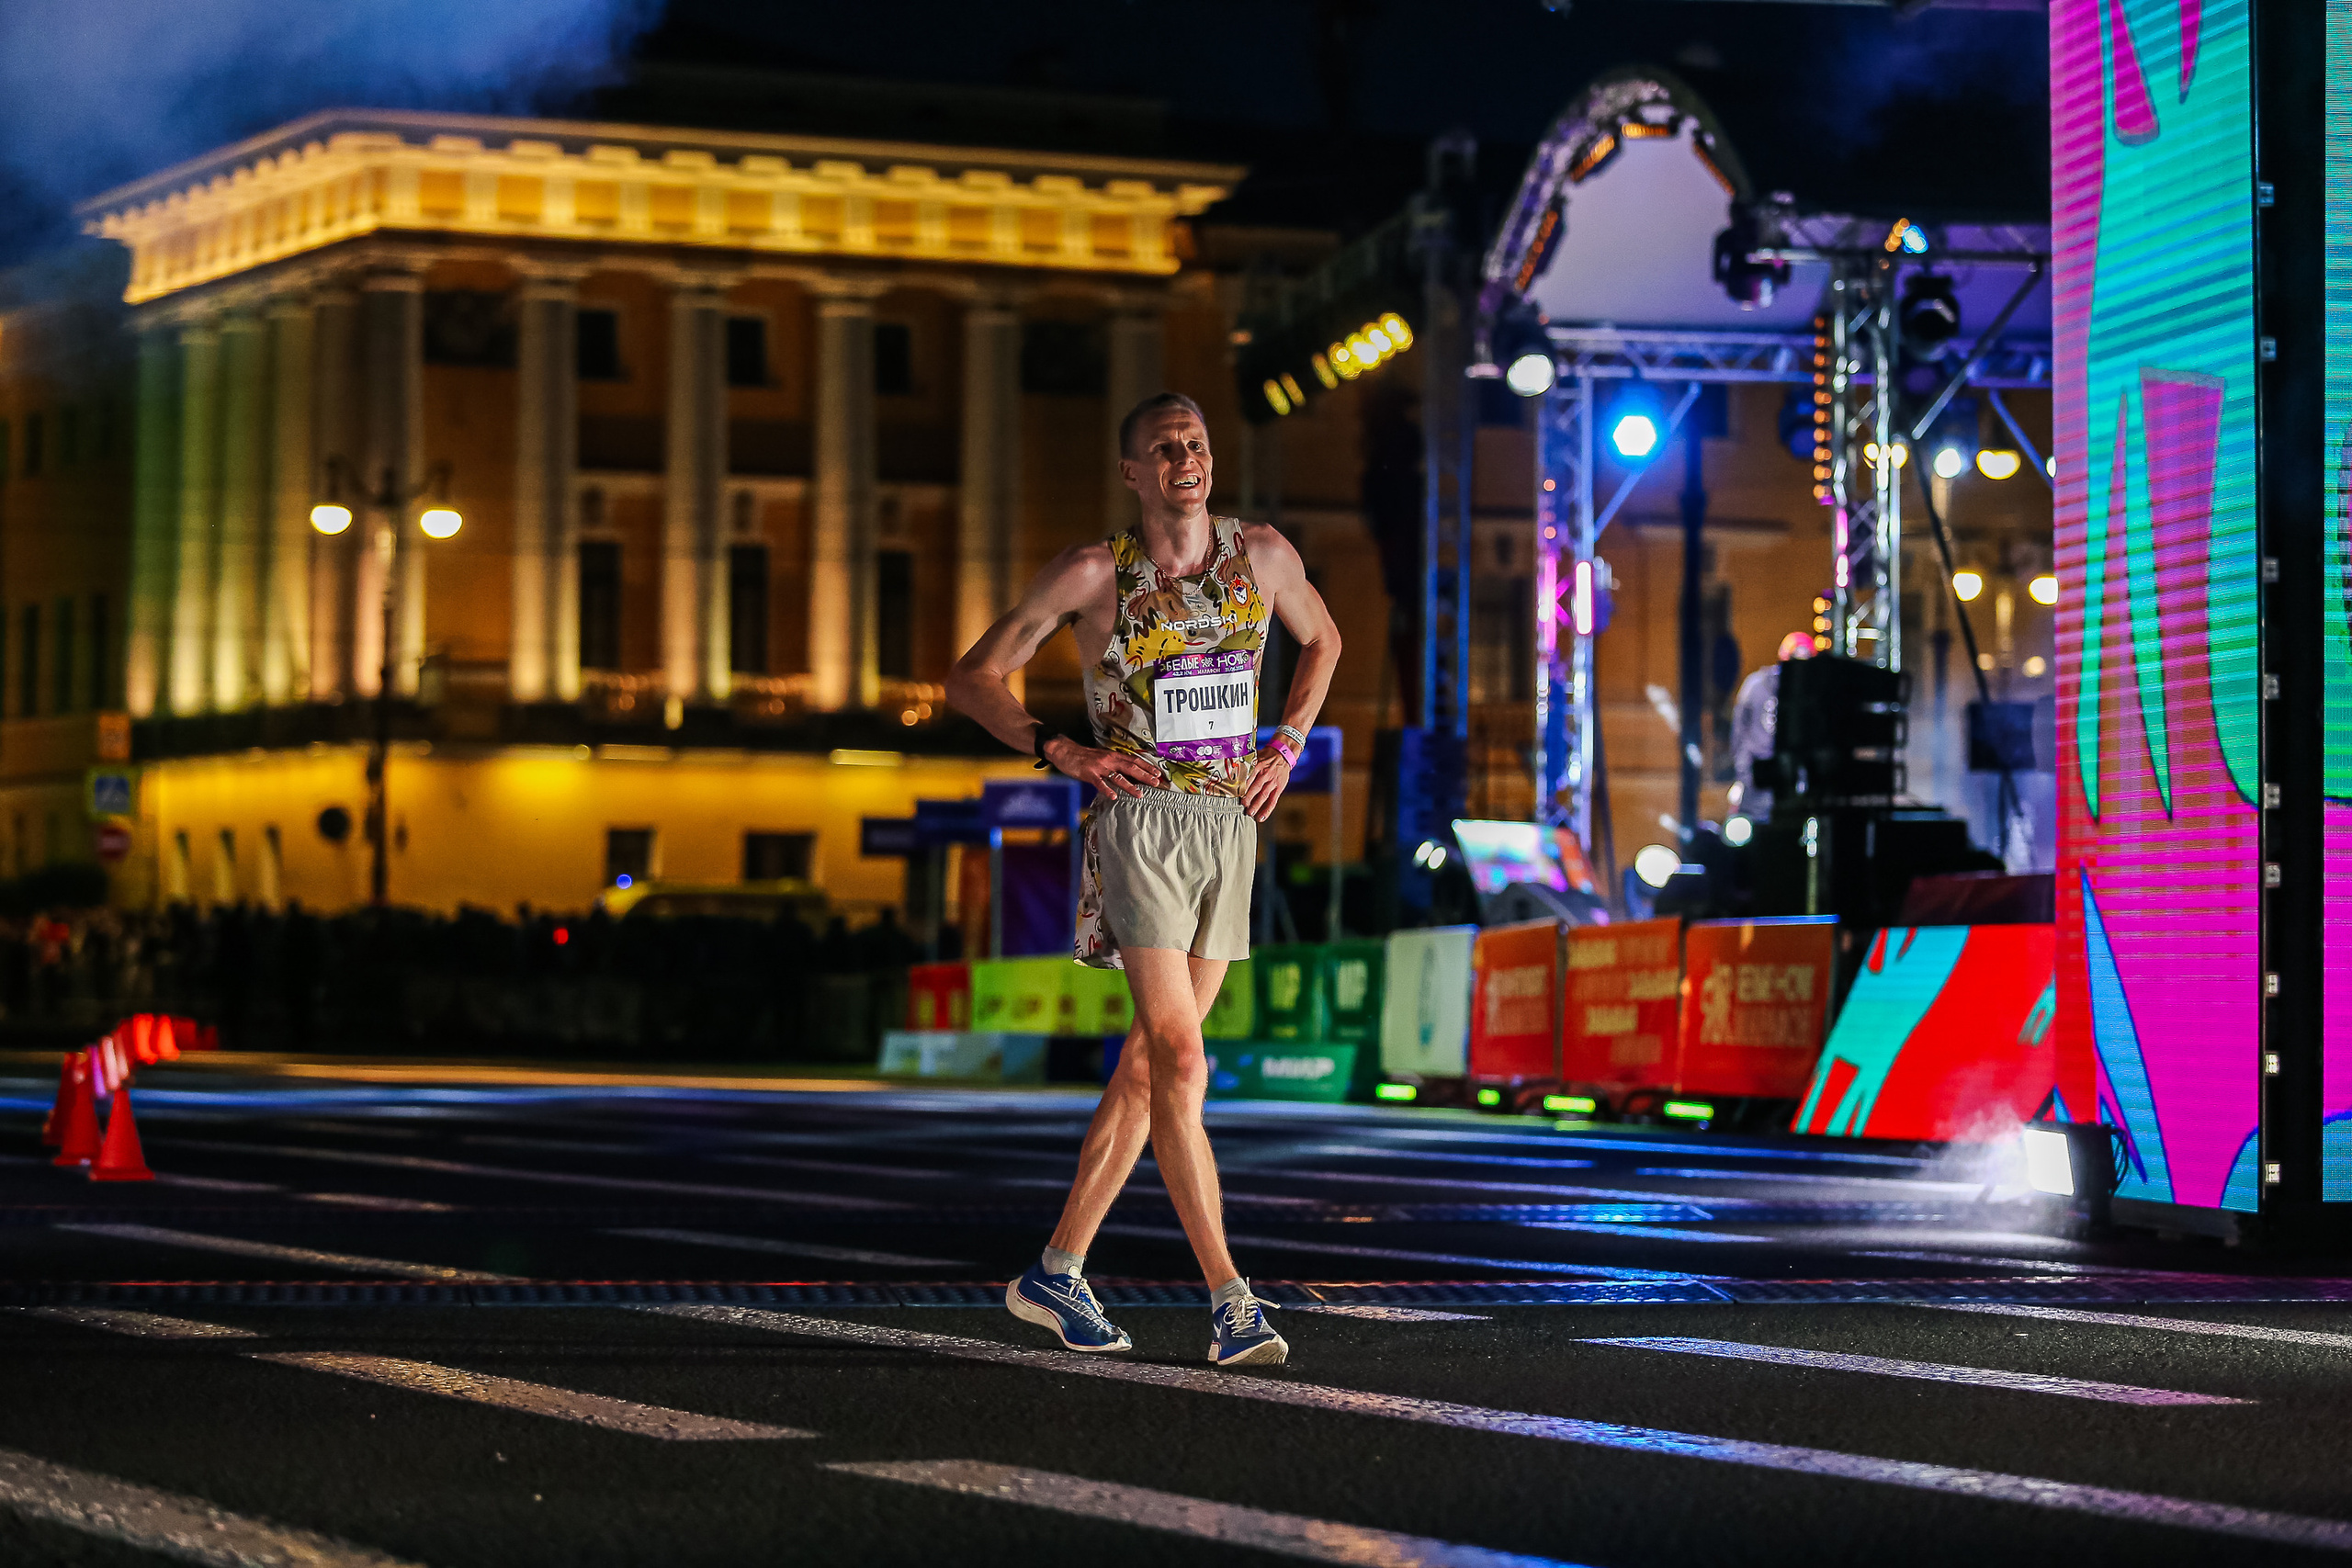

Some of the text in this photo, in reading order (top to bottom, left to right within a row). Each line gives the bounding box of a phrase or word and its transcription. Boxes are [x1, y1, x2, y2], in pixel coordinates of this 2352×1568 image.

[1160, 613, 1238, 632] NORDSKI
[1166, 657, 1200, 672] БЕЛЫЕ
[1163, 682, 1249, 714] ТРОШКИН
[1208, 721, 1215, 730] 7
